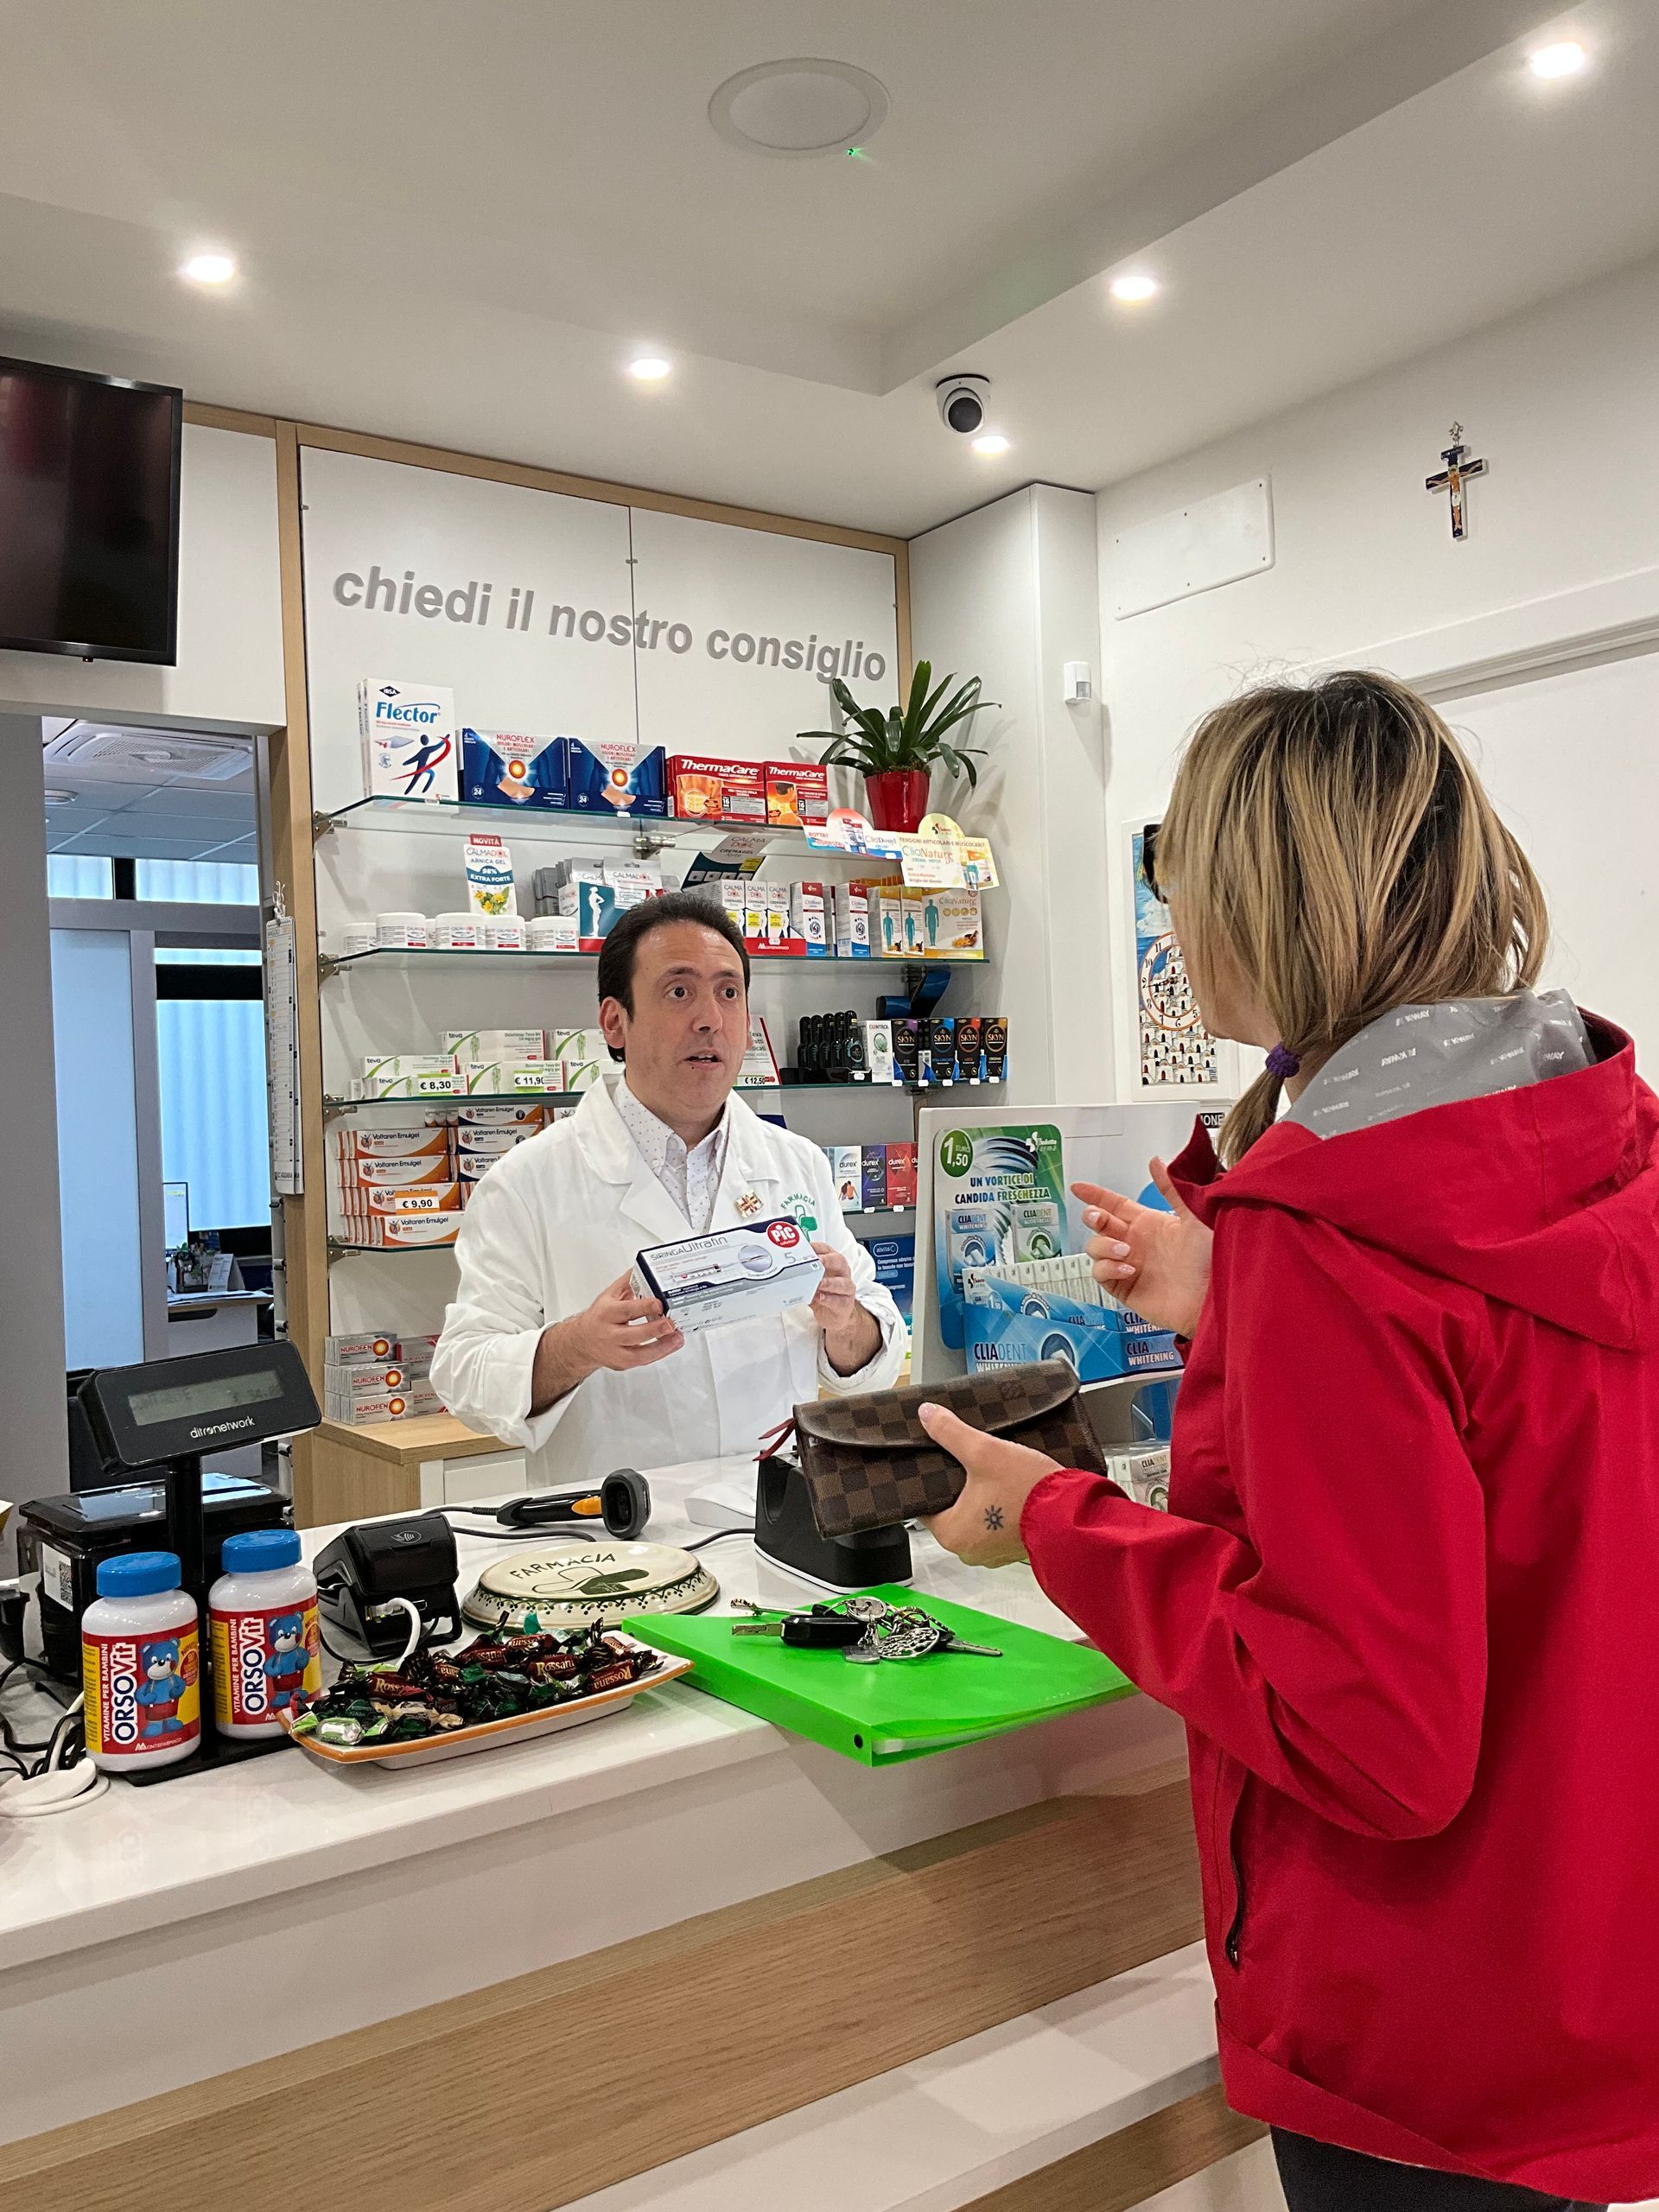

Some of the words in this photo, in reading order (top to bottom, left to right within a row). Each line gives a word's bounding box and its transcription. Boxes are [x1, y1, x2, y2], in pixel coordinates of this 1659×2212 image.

[333, 566, 492, 626] chiedi
[505, 587, 535, 631] il
[550, 603, 692, 655] nostro
[706, 626, 887, 683] consiglio
[375, 701, 438, 724] Flector
[496, 734, 535, 743] NUROFLEX
[601, 743, 637, 753] NUROFLEX
[681, 759, 760, 775] ThermaCare
[769, 766, 825, 779] ThermaCare
[473, 836, 500, 845] NOVITÀ
[467, 848, 508, 857] CALMADOL
[470, 874, 492, 882] EXTRA
[613, 871, 652, 881] CALMADOL
[1155, 942, 1162, 952] 11
[1145, 958, 1153, 968] 10
[1147, 998, 1153, 1009] 8
[1192, 1009, 1198, 1018] 5
[1159, 1014, 1164, 1025] 7
[1175, 1018, 1181, 1027] 6
[897, 1035, 915, 1044] SKYN
[933, 1033, 951, 1042] SKYN
[960, 1033, 977, 1042] SKYN
[420, 1082, 427, 1090] €
[429, 1080, 451, 1090] 8,30
[514, 1077, 521, 1085] €
[887, 1157, 906, 1166] durex
[969, 1177, 983, 1187] UN
[985, 1174, 1021, 1186] VORTICE
[1022, 1173, 1034, 1185] DI
[780, 1193, 816, 1209] FARMACIA
[955, 1192, 995, 1205] CANDIDA
[996, 1188, 1051, 1202] FRESCHEZZA
[402, 1200, 409, 1209] €
[411, 1198, 433, 1209] 9,90
[957, 1213, 987, 1224] CLIADENT
[1023, 1208, 1052, 1218] CLIADENT
[784, 1251, 796, 1264] 5
[340, 1344, 372, 1353] NUROFEN
[974, 1343, 1027, 1360] CLIADENT
[1128, 1351, 1174, 1366] WHITENING
[353, 1375, 385, 1384] NUROFEN
[356, 1403, 388, 1413] NUROFEN
[190, 1415, 255, 1439] ditronetwork
[509, 1553, 616, 1580] FARMACIA
[229, 1618, 238, 1656] BAMBINI
[241, 1618, 265, 1713] ORSOVit
[593, 1666, 632, 1690] Rossana
[373, 1677, 404, 1694] Ross
[112, 1643, 137, 1742] ORSOVit
[231, 1670, 241, 1714] VITAMINE
[102, 1700, 111, 1743] VITAMINE
[135, 1737, 182, 1751] MONTEFARMACO
